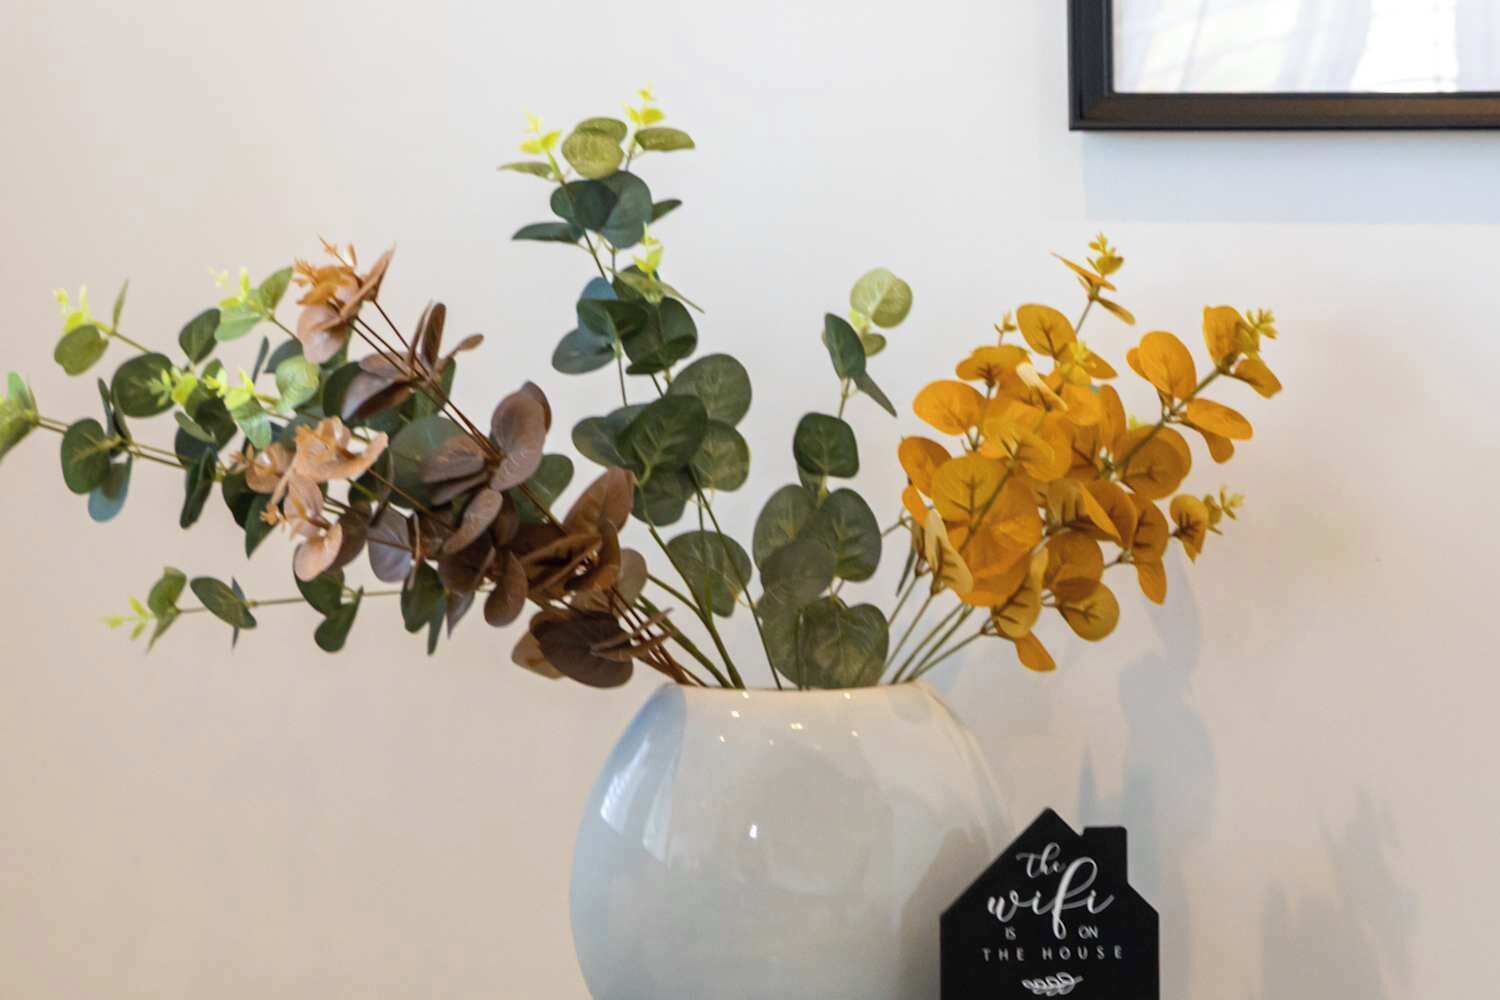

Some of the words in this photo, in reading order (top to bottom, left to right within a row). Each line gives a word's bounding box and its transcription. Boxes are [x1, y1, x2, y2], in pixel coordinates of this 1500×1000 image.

[987, 856, 1116, 940] wifi
[1005, 926, 1017, 941] IS
[1078, 924, 1100, 939] ON
[982, 948, 1025, 962] THE
[1042, 945, 1123, 961] HOUSE
